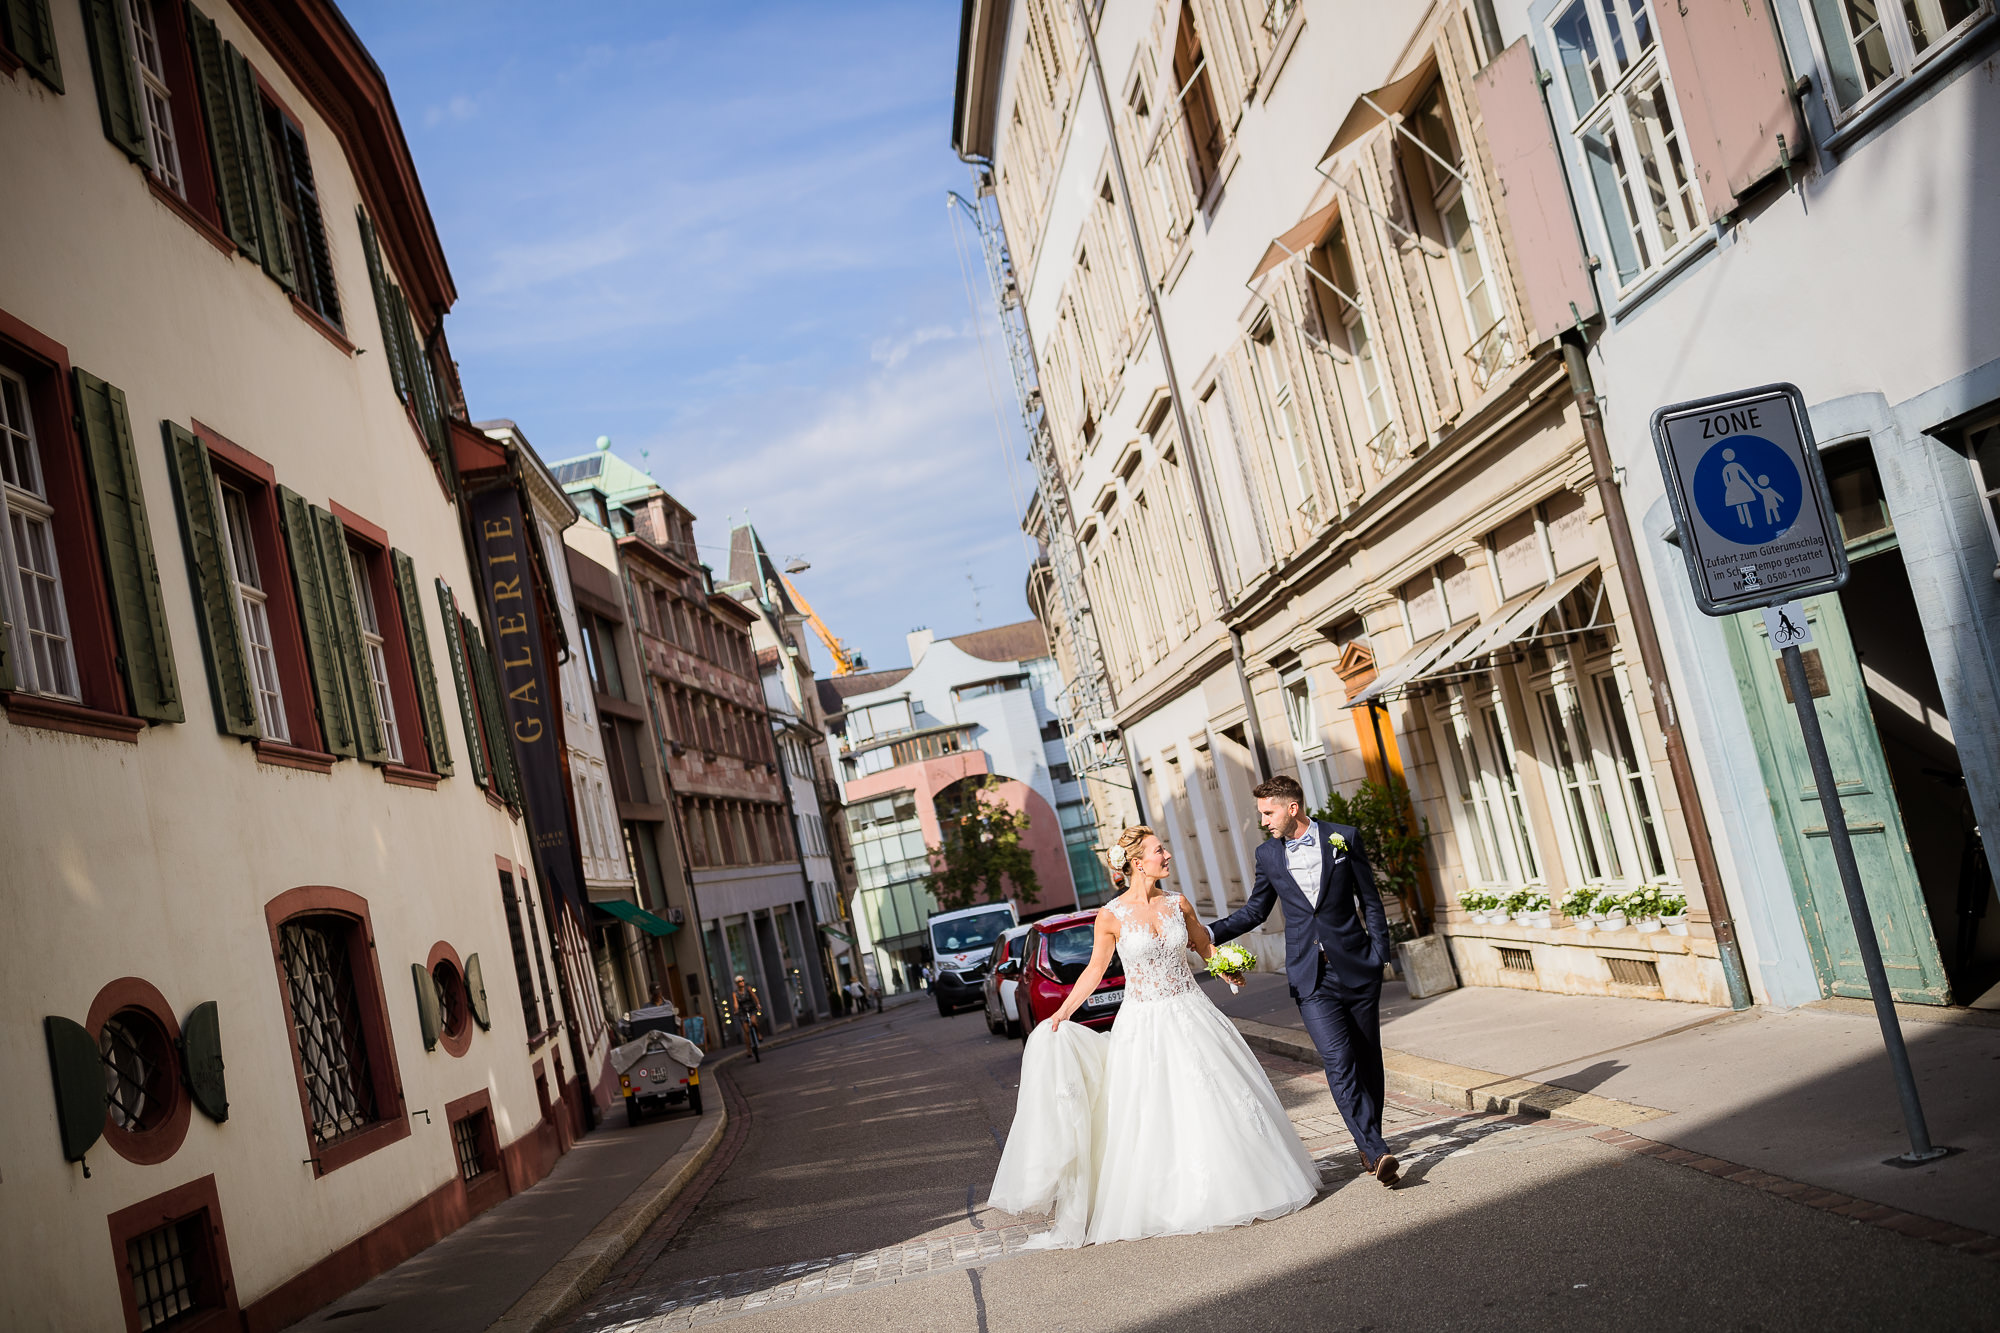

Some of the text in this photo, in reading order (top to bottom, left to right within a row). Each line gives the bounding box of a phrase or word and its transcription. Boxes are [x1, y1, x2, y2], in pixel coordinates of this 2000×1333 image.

[1699, 408, 1762, 440] ZONE
[1705, 536, 1825, 568] Zufahrt zum Güterumschlag
[1713, 549, 1824, 581] im Schtempo gestattet
[483, 515, 544, 743] GALERIE
